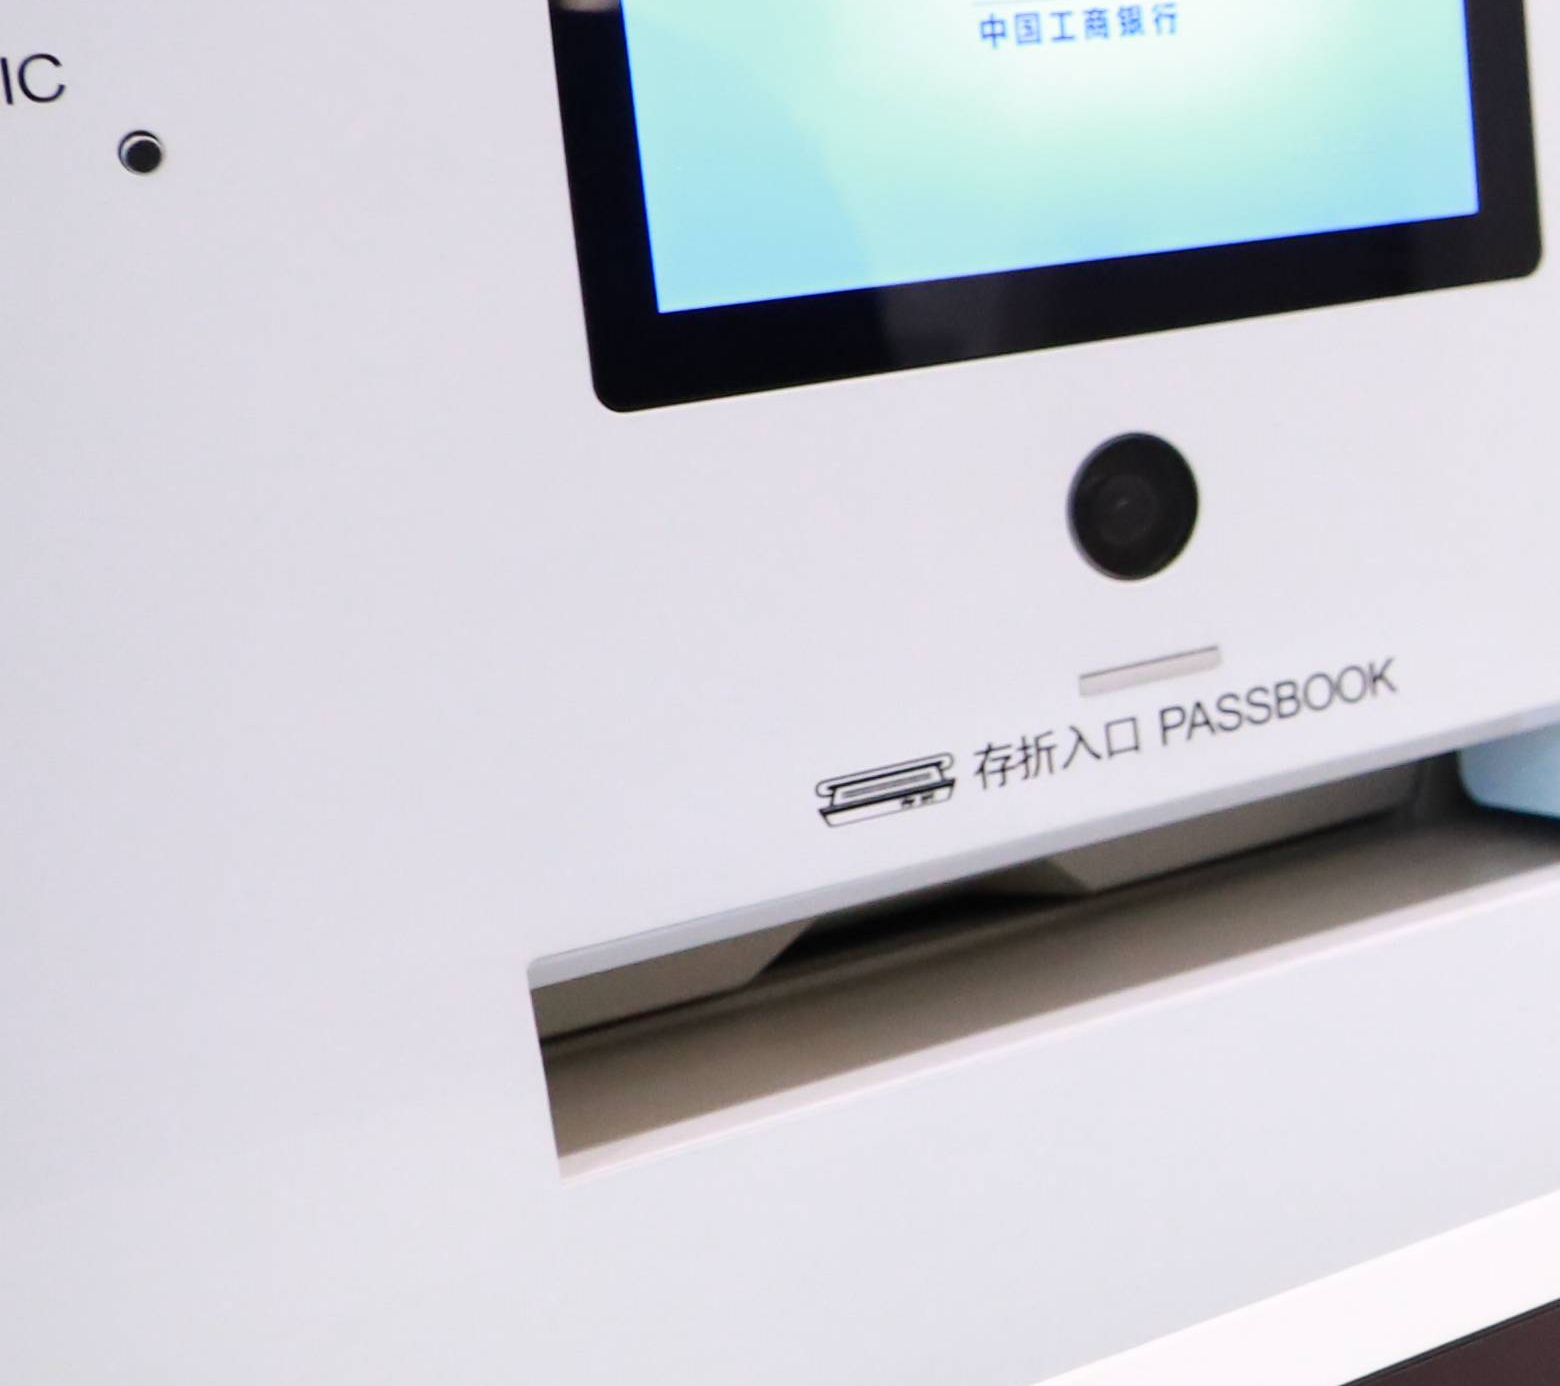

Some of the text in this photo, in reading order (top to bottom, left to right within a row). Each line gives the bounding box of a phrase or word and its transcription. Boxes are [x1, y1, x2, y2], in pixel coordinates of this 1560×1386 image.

[979, 1, 1179, 50] 中国工商银行
[973, 657, 1399, 790] 存折入口 PASSBOOK
